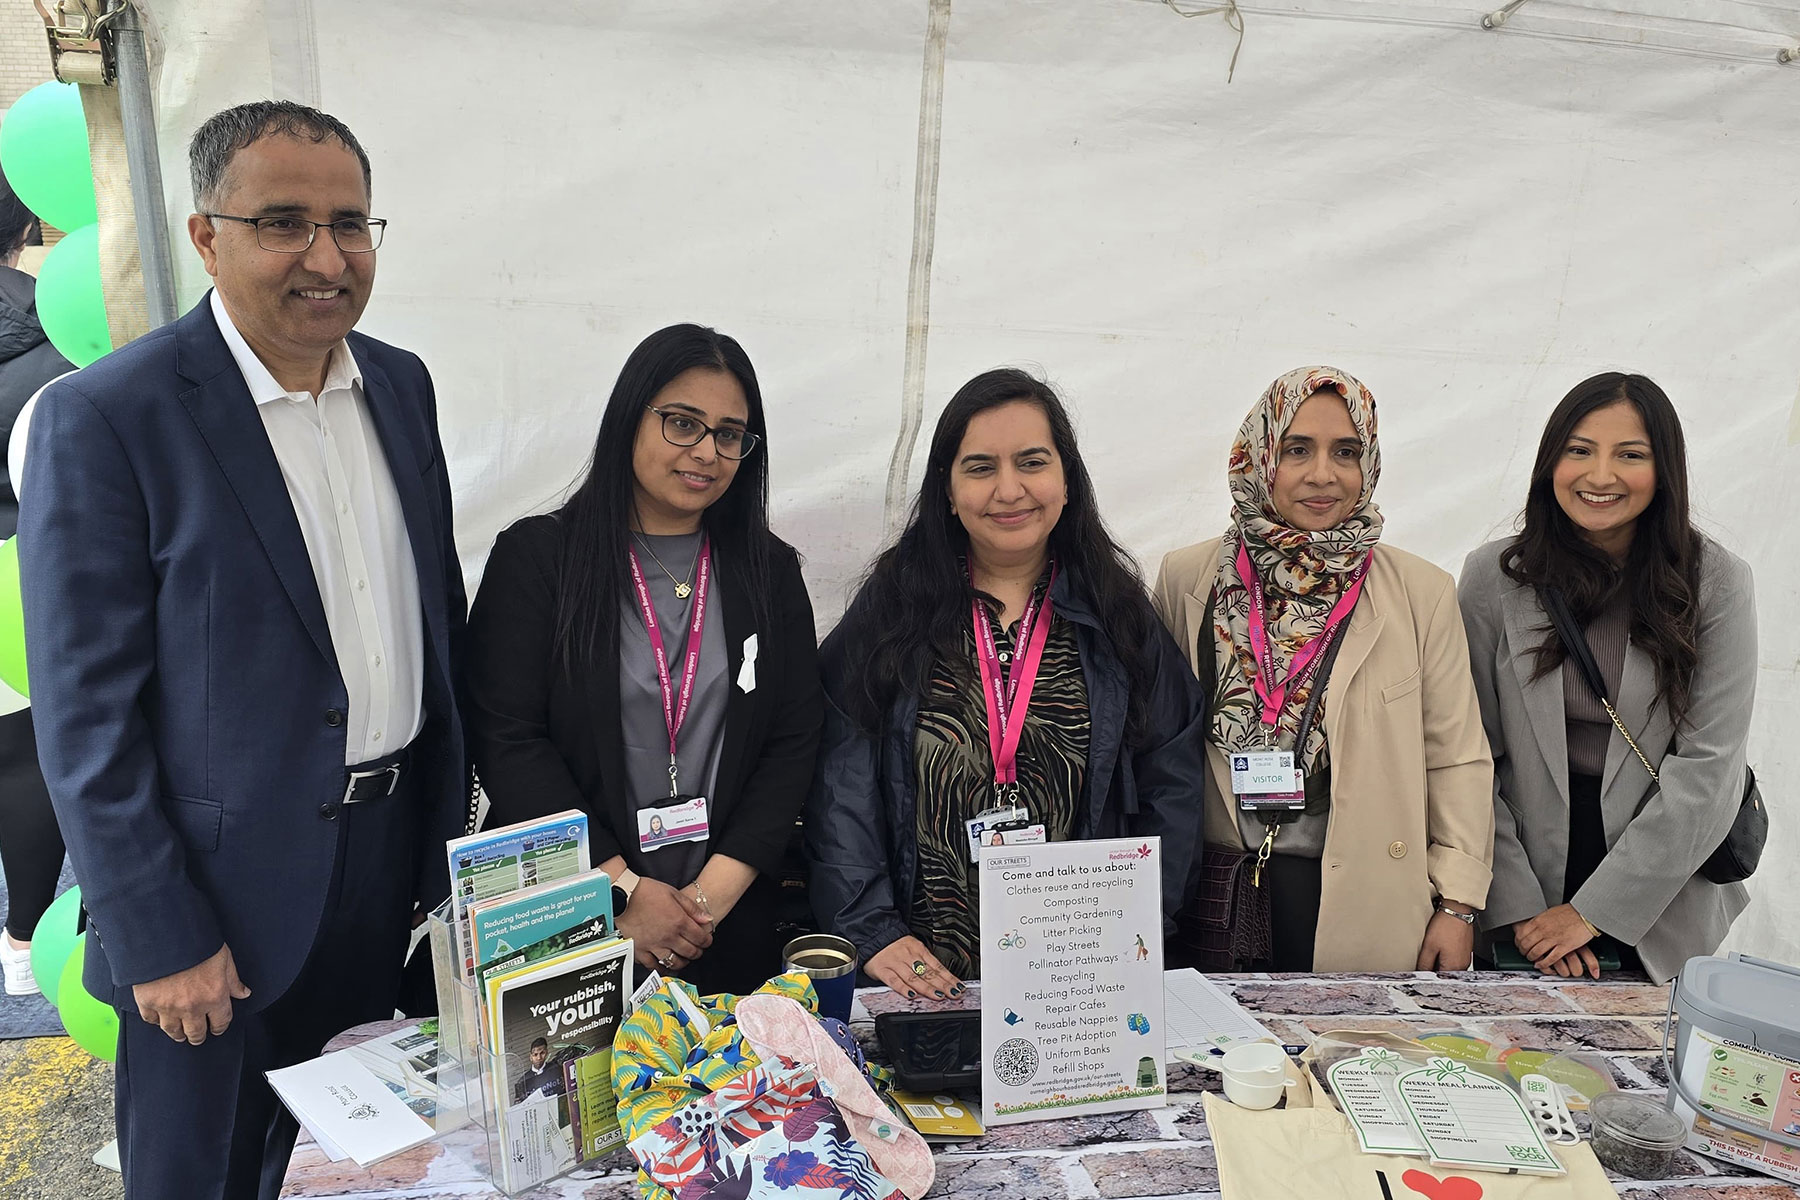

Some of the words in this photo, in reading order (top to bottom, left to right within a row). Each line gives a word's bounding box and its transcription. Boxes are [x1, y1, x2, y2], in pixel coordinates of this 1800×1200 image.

[1264, 654, 1275, 690] REDBRIDG
[1252, 775, 1284, 783] VISITOR
[1109, 852, 1139, 860] Redbridge
[1002, 871, 1032, 881] Come
[1035, 867, 1054, 878] and
[1057, 864, 1076, 876] talk
[1079, 866, 1089, 874] to
[1092, 865, 1102, 874] us
[1105, 862, 1136, 872] about:
[1006, 884, 1042, 896] Clothes
[1044, 884, 1069, 893] reuse
[1071, 879, 1089, 890] and
[1092, 876, 1134, 892] recycling
[484, 915, 515, 929] Reducing
[515, 910, 530, 920] food
[531, 905, 550, 915] waste
[556, 899, 574, 911] great
[583, 891, 598, 901] your
[1043, 896, 1099, 910] Composting
[485, 926, 509, 940] pocket,
[510, 919, 530, 931] health
[531, 916, 544, 925] and
[544, 912, 555, 921] the
[555, 907, 575, 919] planet
[1020, 912, 1071, 925] Community
[1073, 908, 1123, 921] Gardening
[568, 929, 593, 945] Redbridge
[1042, 928, 1067, 938] Litter
[1069, 925, 1102, 936] Picking
[1046, 943, 1066, 954] Play
[1068, 941, 1100, 950] Streets
[1029, 958, 1072, 970] Pollinator
[1075, 954, 1119, 966] Pathways
[579, 969, 608, 982] Redbridge
[1051, 971, 1096, 984] Recycling
[530, 997, 562, 1018] Your
[563, 979, 616, 1005] rubbish,
[1024, 989, 1068, 1001] Reducing
[1070, 985, 1094, 996] Food
[1096, 983, 1126, 993] Waste
[546, 995, 604, 1036] your
[1045, 1004, 1076, 1016] Repair
[1079, 999, 1106, 1010] Cafes
[561, 1015, 614, 1040] responsibility
[1034, 1018, 1077, 1031] Reusable
[1079, 1014, 1119, 1027] Nappies
[1037, 1036, 1058, 1046] Tree
[1060, 1034, 1073, 1043] Pit
[1074, 1030, 1117, 1042] Adoption
[1045, 1049, 1081, 1060] Uniform
[1083, 1044, 1111, 1056] Banks
[1052, 1063, 1076, 1075] Refill
[1078, 1060, 1105, 1073] Shops
[597, 1133, 613, 1144] OUR
[1505, 1145, 1538, 1153] LOVE
[1510, 1151, 1546, 1160] FOOD
[1709, 1139, 1727, 1149] THIS
[1736, 1150, 1755, 1159] NOT
[1763, 1157, 1798, 1172] RUBBISH
